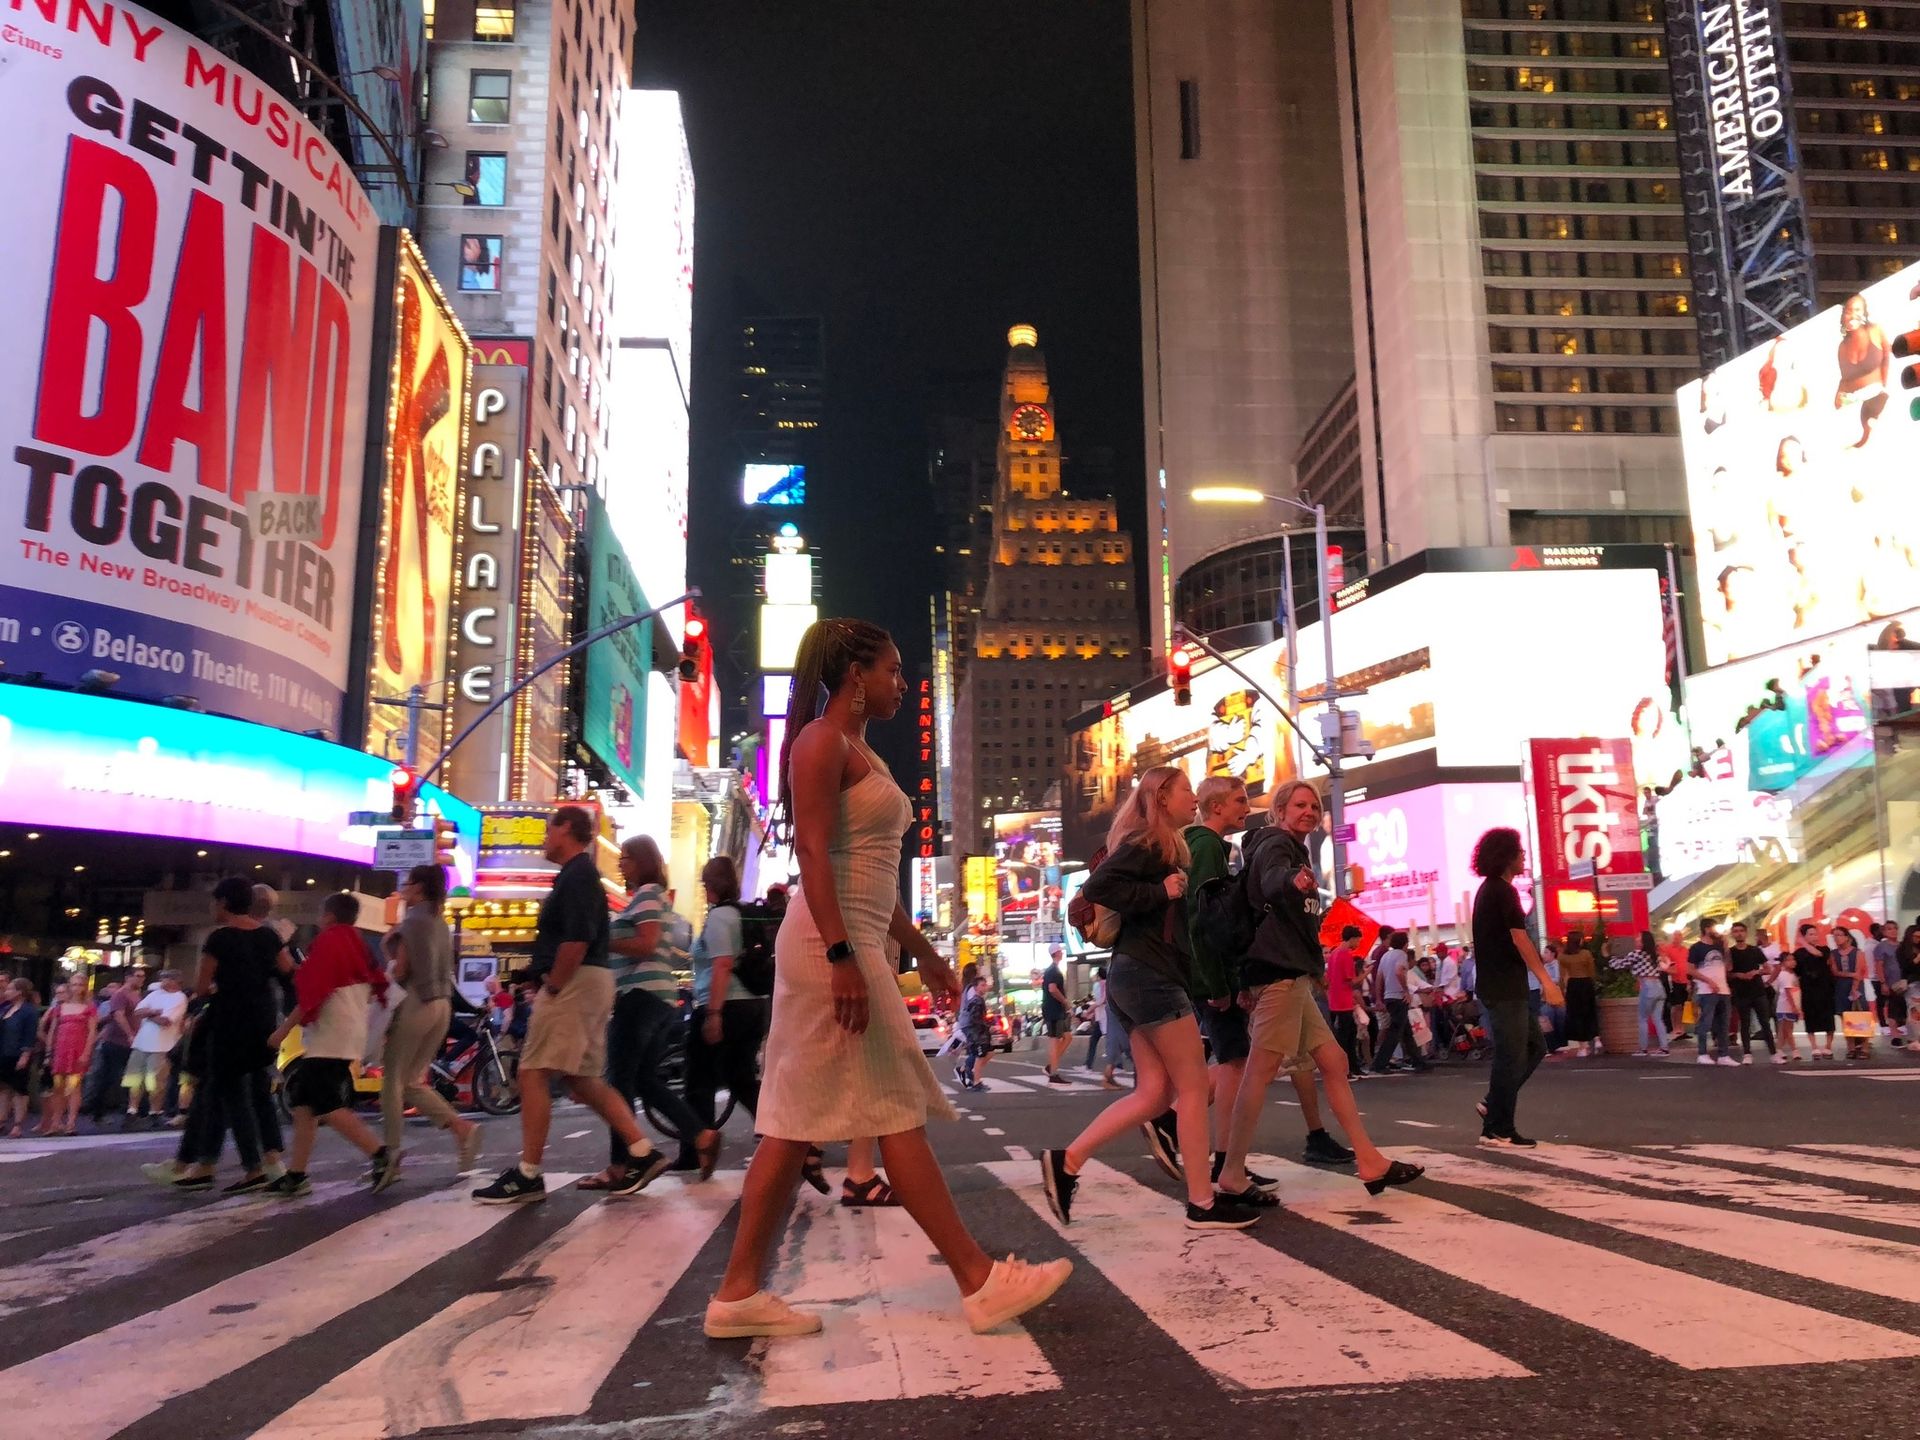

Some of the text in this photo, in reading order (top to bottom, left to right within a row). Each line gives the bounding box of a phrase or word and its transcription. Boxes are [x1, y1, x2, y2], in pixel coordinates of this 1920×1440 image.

[1, 24, 63, 60] Times
[1701, 4, 1753, 195] AMERICAN
[327, 223, 355, 301] THE
[34, 133, 351, 551] BAND
[14, 445, 335, 632] TOGETHER
[258, 499, 320, 536] BACK
[459, 388, 507, 704] PALACE
[1543, 546, 1604, 556] MARRIOTT
[19, 539, 69, 567] The
[80, 552, 134, 582] New
[143, 568, 240, 614] Broadway
[1544, 556, 1599, 566] MARQUIS
[92, 628, 186, 674] Belasco
[192, 648, 264, 700] Theatre,
[919, 680, 933, 762] ERNST
[919, 777, 933, 791] &
[1556, 747, 1622, 869] tkts
